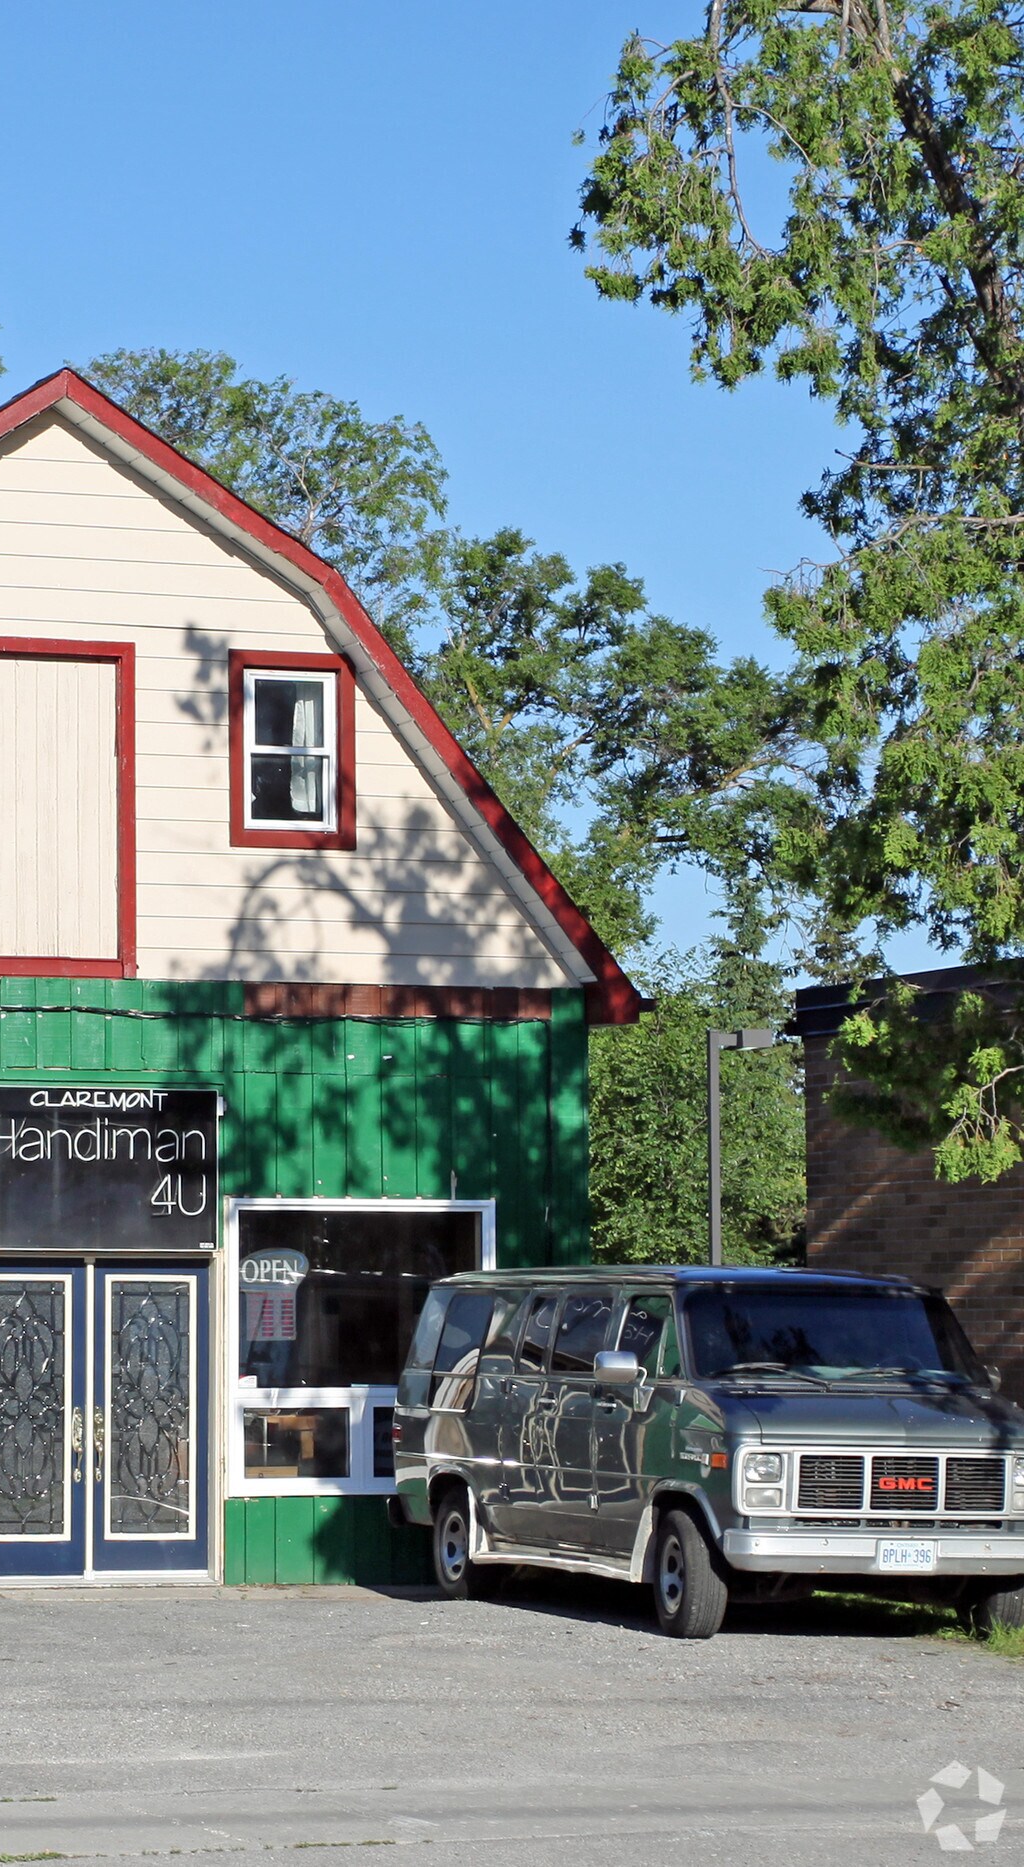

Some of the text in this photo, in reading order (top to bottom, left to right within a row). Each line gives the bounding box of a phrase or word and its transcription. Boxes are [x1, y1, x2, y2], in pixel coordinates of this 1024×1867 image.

[29, 1089, 168, 1112] CLAREMONT
[150, 1173, 206, 1216] 4U
[242, 1259, 297, 1283] OPEN
[879, 1477, 933, 1490] GMC
[913, 1549, 931, 1563] 396
